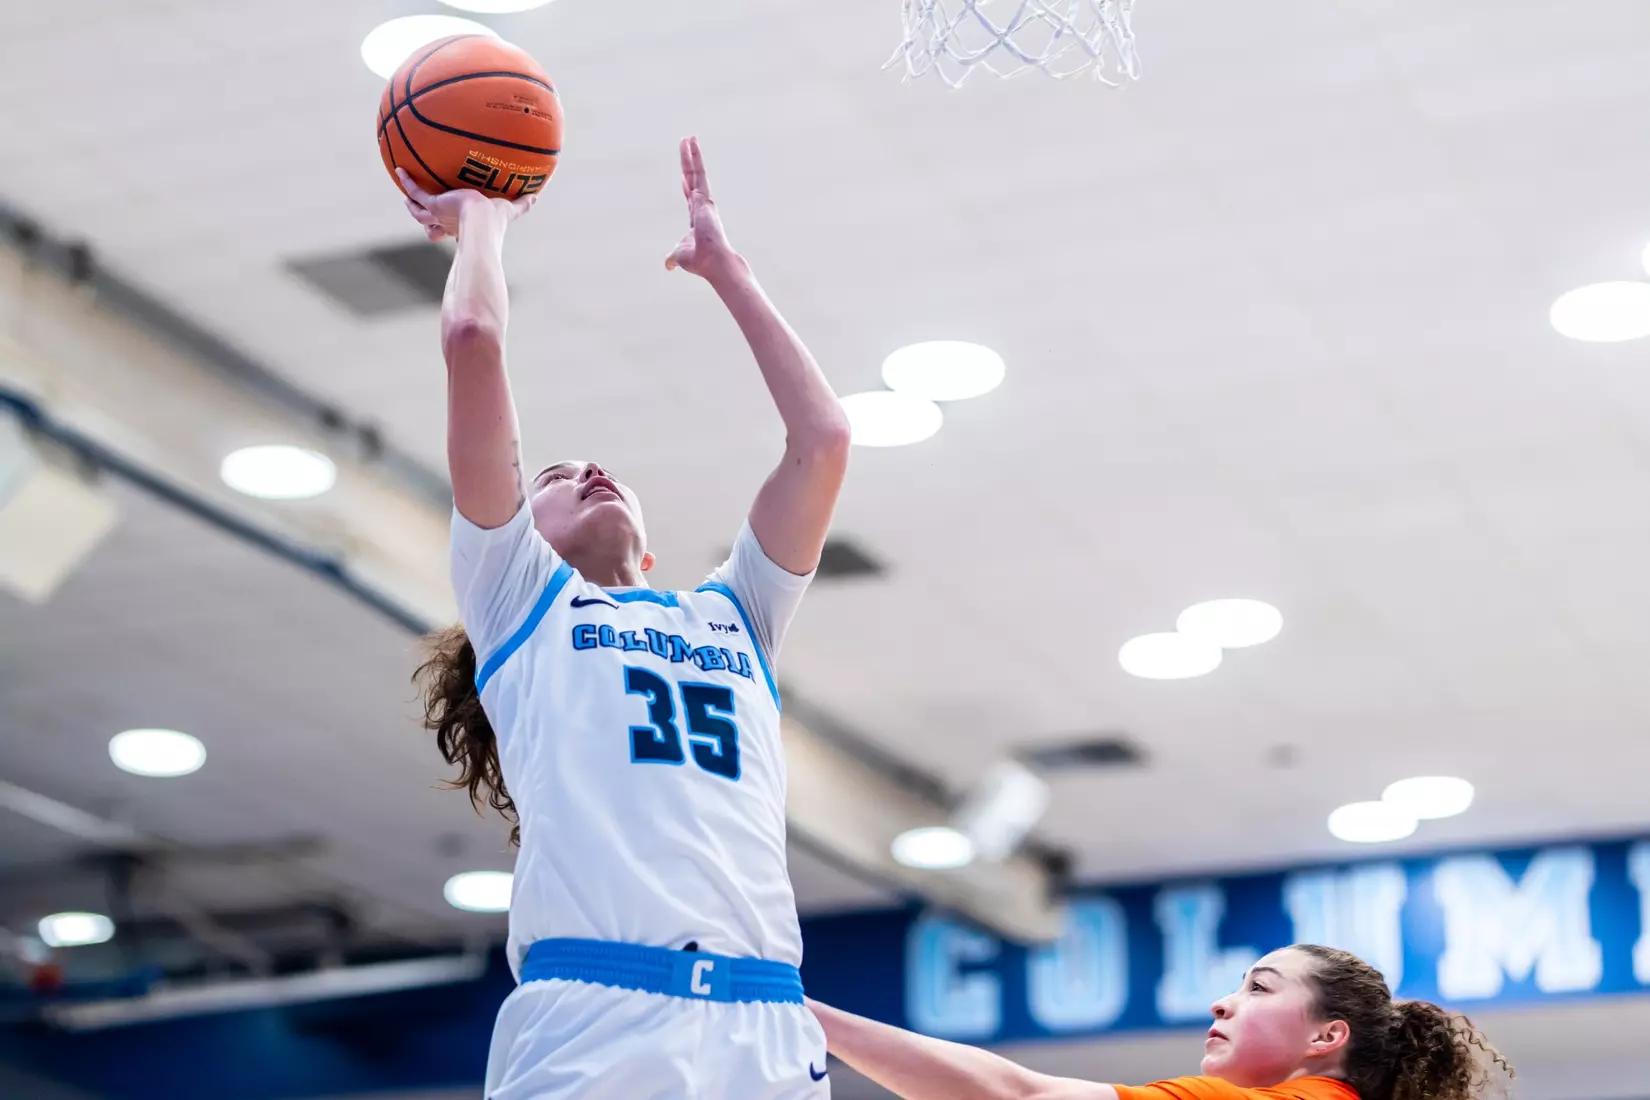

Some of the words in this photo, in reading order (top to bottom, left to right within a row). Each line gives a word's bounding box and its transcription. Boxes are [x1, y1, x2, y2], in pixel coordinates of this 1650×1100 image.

[457, 156, 547, 197] ELITE
[707, 621, 729, 635] Ivy
[572, 624, 756, 684] COLUMBIA
[623, 665, 741, 781] 35
[907, 842, 1650, 1037] COLUM
[690, 959, 714, 996] C
